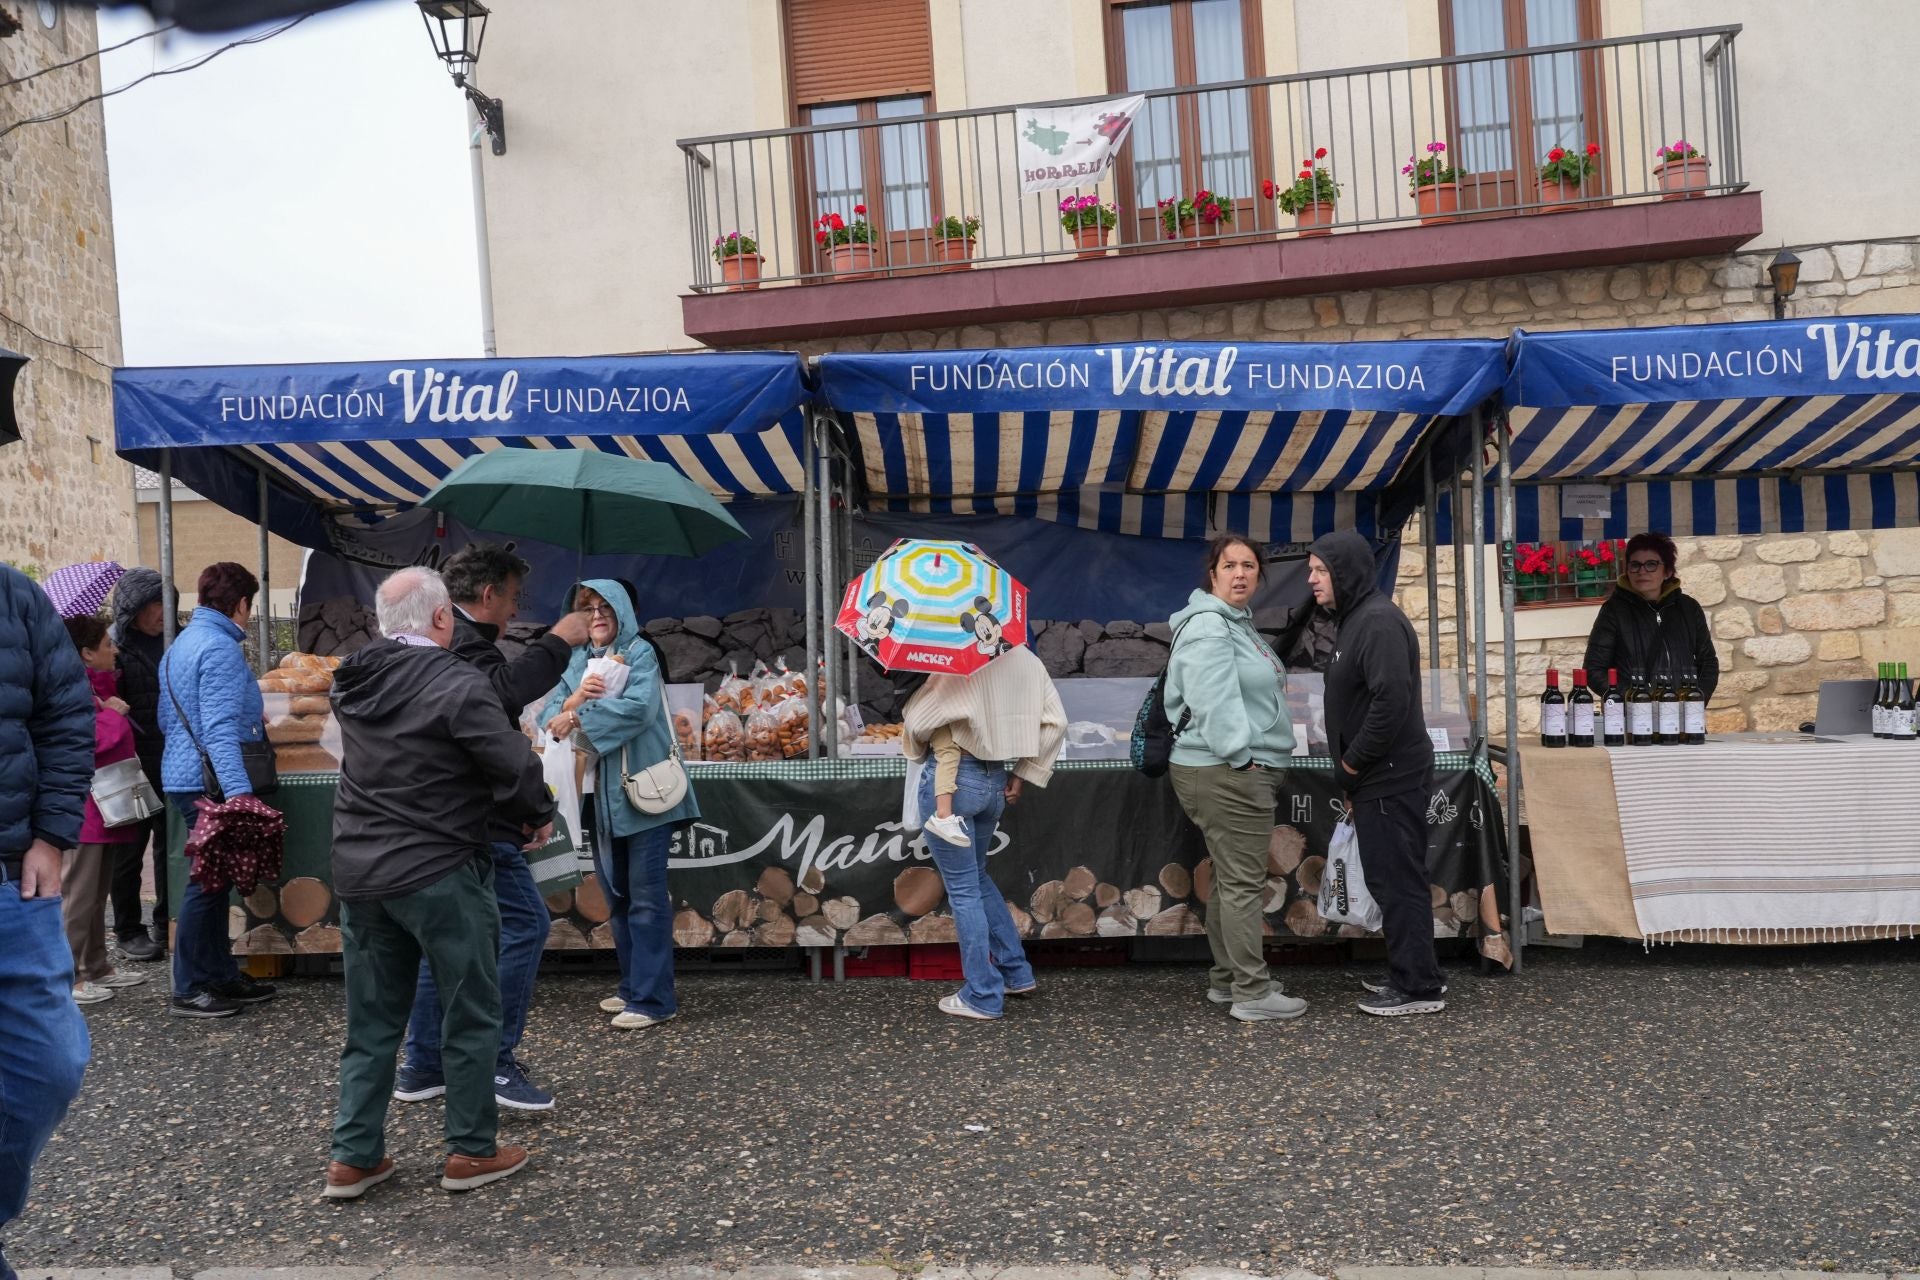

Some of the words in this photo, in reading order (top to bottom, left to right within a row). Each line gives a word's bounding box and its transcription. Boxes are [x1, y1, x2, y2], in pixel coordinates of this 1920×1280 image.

[910, 358, 1090, 391] FUNDACIÓN
[1094, 346, 1238, 396] Vital
[1247, 363, 1426, 391] FUNDAZIOA
[1612, 345, 1803, 382] FUNDACIÓN
[1806, 323, 1920, 381] Vita
[221, 387, 384, 422] FUNDACIÓN
[388, 367, 520, 423] Vital
[526, 387, 691, 413] FUNDAZIOA
[906, 651, 954, 666] MICKEY
